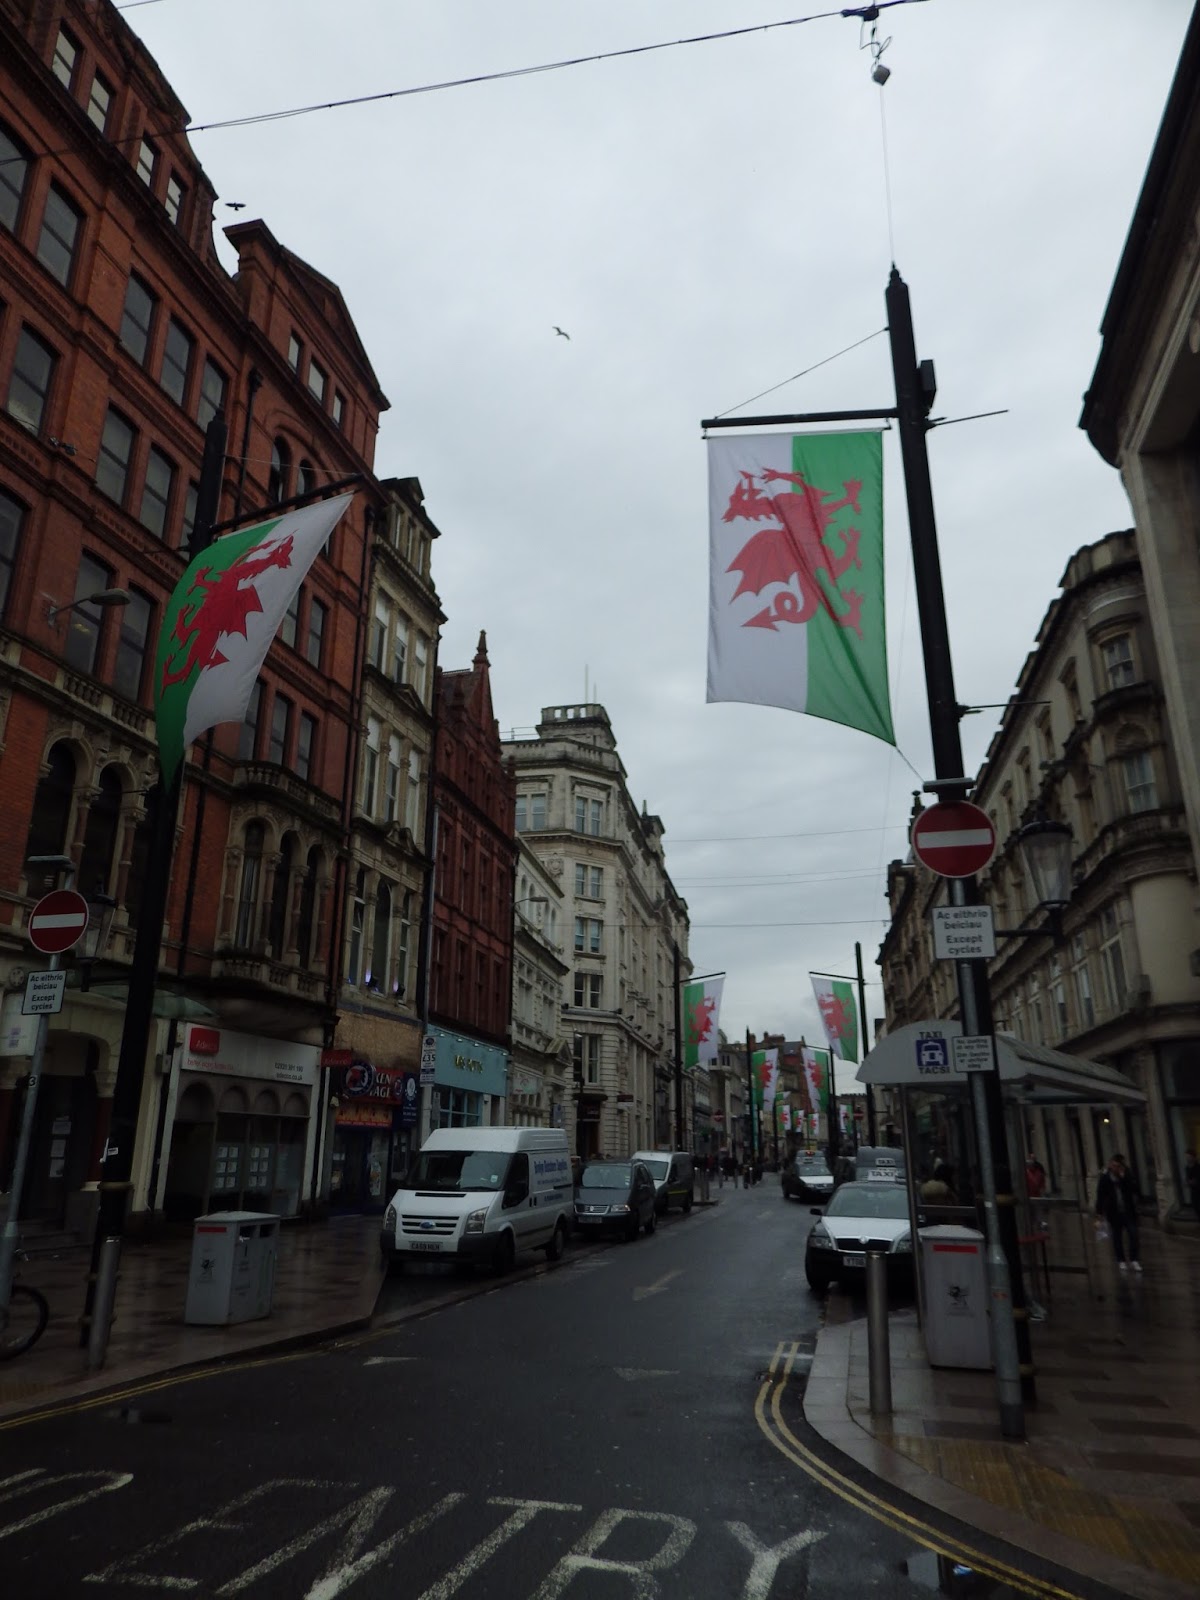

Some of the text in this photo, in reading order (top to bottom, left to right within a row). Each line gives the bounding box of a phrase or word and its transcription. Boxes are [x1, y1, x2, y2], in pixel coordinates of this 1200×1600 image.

[937, 909, 988, 919] Ac eithrio
[944, 920, 982, 930] beiciau
[946, 935, 983, 944] Except
[948, 945, 982, 955] cycles
[31, 994, 56, 1003] Except
[31, 1002, 53, 1011] cycles
[919, 1031, 943, 1039] TAXI
[81, 1476, 829, 1600] ENTRY
